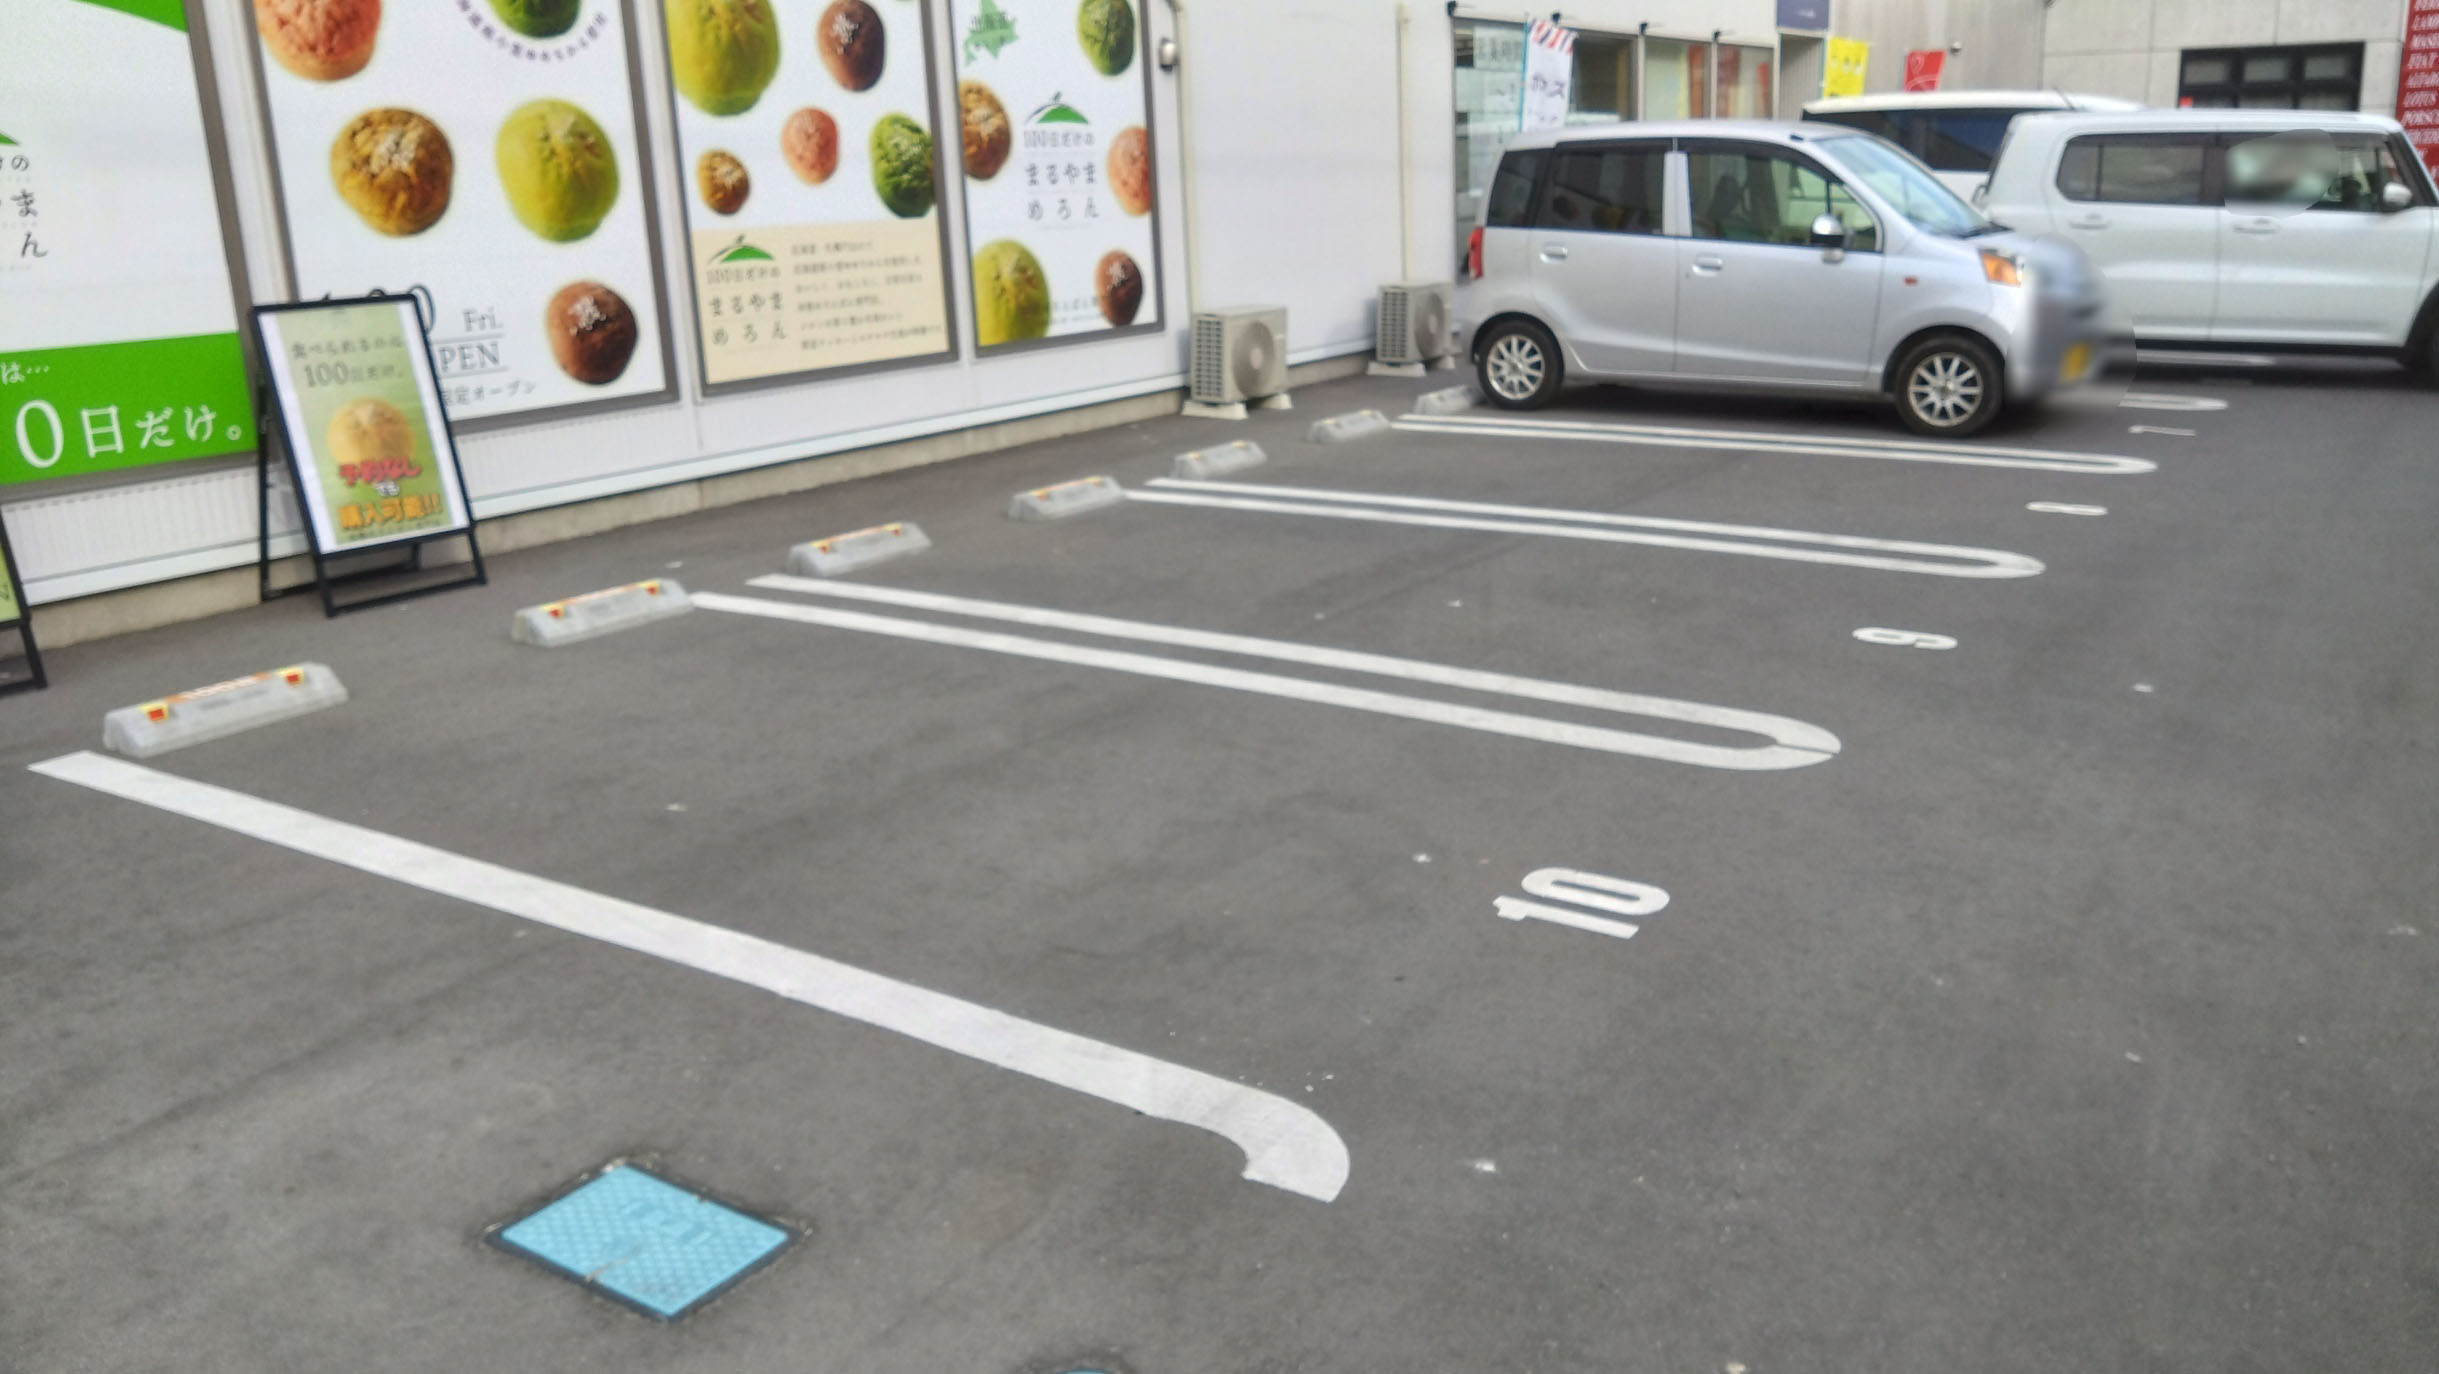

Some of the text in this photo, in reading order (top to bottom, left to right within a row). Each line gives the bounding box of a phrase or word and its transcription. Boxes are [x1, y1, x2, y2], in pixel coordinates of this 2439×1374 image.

[2403, 91, 2437, 107] LOTUS
[1025, 162, 1098, 187] まるやま
[1027, 196, 1100, 221] めろん
[709, 291, 784, 317] まるやま
[463, 307, 504, 332] Fri.
[711, 321, 787, 346] めろん
[438, 341, 501, 372] PEN
[1852, 627, 1959, 650] 9
[1492, 866, 1671, 940] 10
